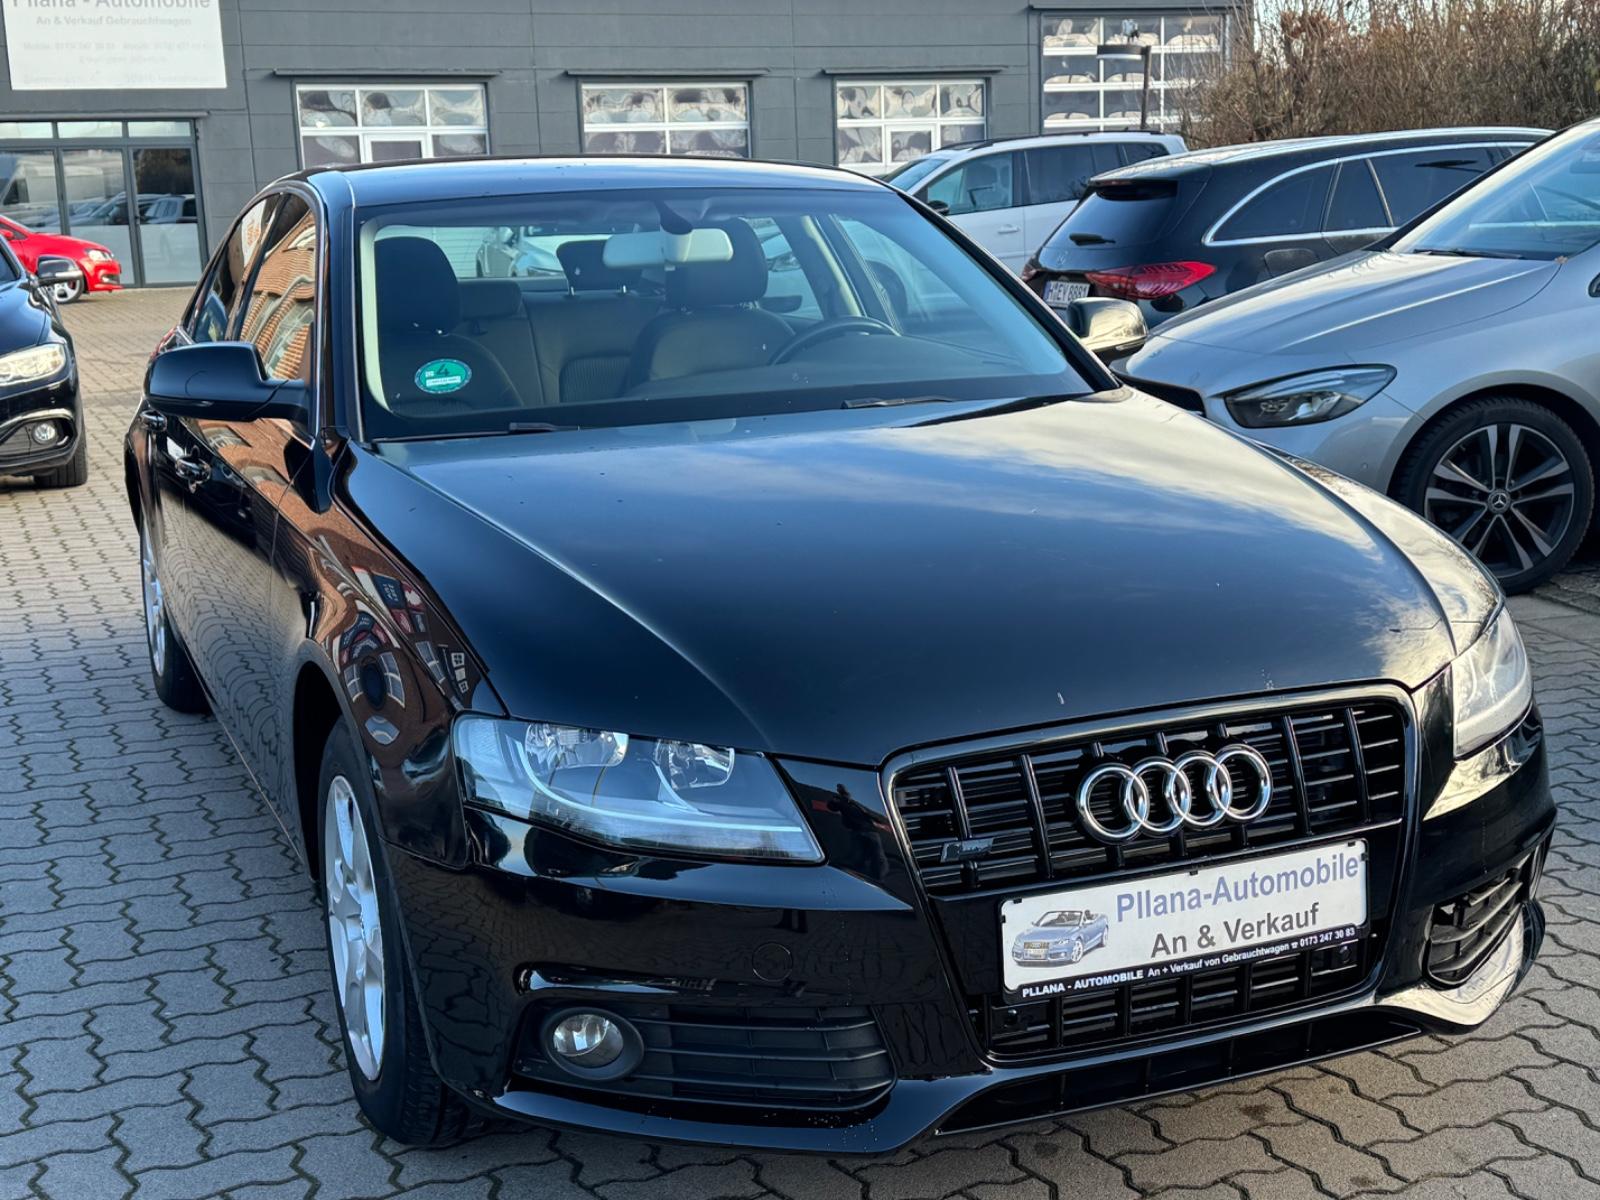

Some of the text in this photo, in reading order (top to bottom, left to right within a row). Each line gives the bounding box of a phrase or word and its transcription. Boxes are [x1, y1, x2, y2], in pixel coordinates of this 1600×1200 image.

[36, 15, 192, 27] An & Verkauf Gebrauchtwagen
[436, 363, 450, 376] 4
[1117, 852, 1359, 923] Pllana-Automobile
[1150, 901, 1320, 958] An & Verkauf
[1022, 983, 1066, 998] PLLANA
[1073, 969, 1144, 990] AUTOMOBILE
[1147, 966, 1161, 977] An
[1170, 958, 1204, 974] Verkauf
[1204, 958, 1221, 968] von
[1221, 943, 1290, 964] Gebrauchtwagen
[1299, 936, 1318, 948] 0173
[1319, 932, 1333, 944] 247
[1334, 929, 1345, 940] 30
[1345, 926, 1356, 937] 83
